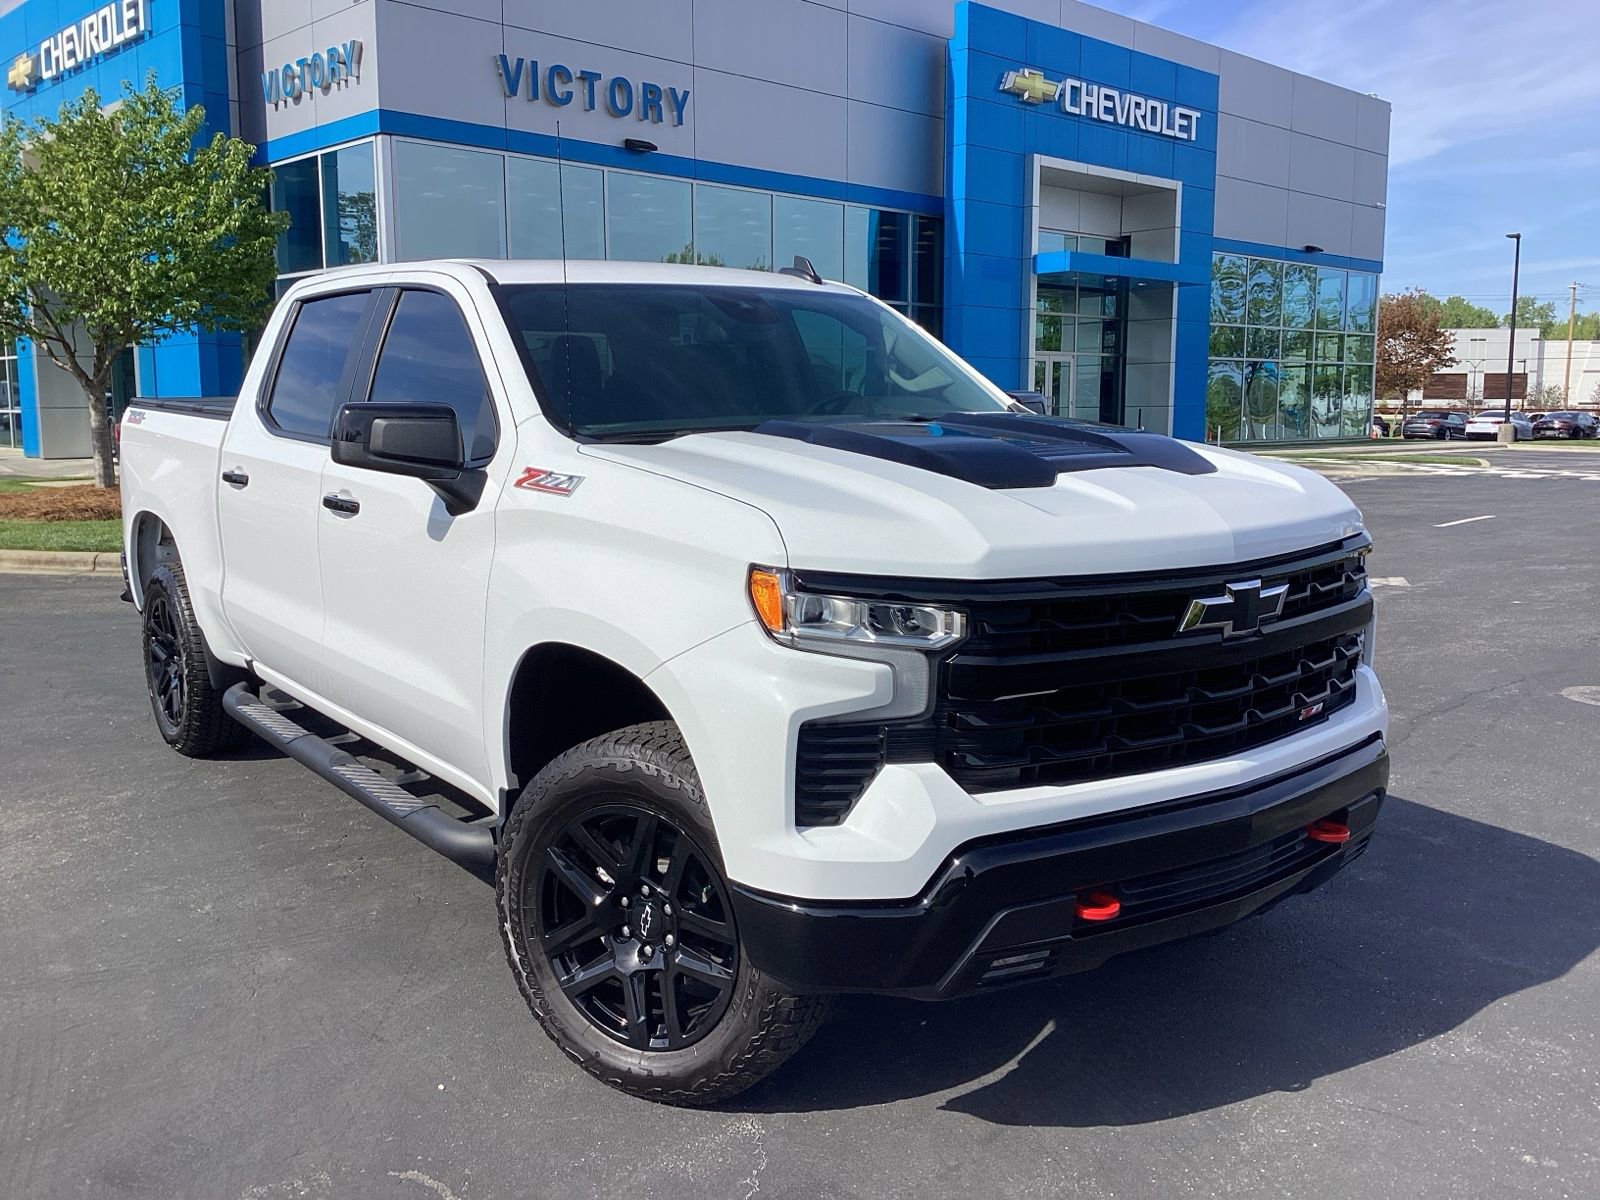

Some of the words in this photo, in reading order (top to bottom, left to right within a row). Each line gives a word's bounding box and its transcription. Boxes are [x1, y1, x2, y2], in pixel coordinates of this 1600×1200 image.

[41, 0, 145, 79] CHEVROLET
[261, 40, 357, 104] VICTORY
[499, 54, 690, 126] VICTORY
[1064, 78, 1200, 140] CHEVROLET
[514, 466, 586, 498] Z71
